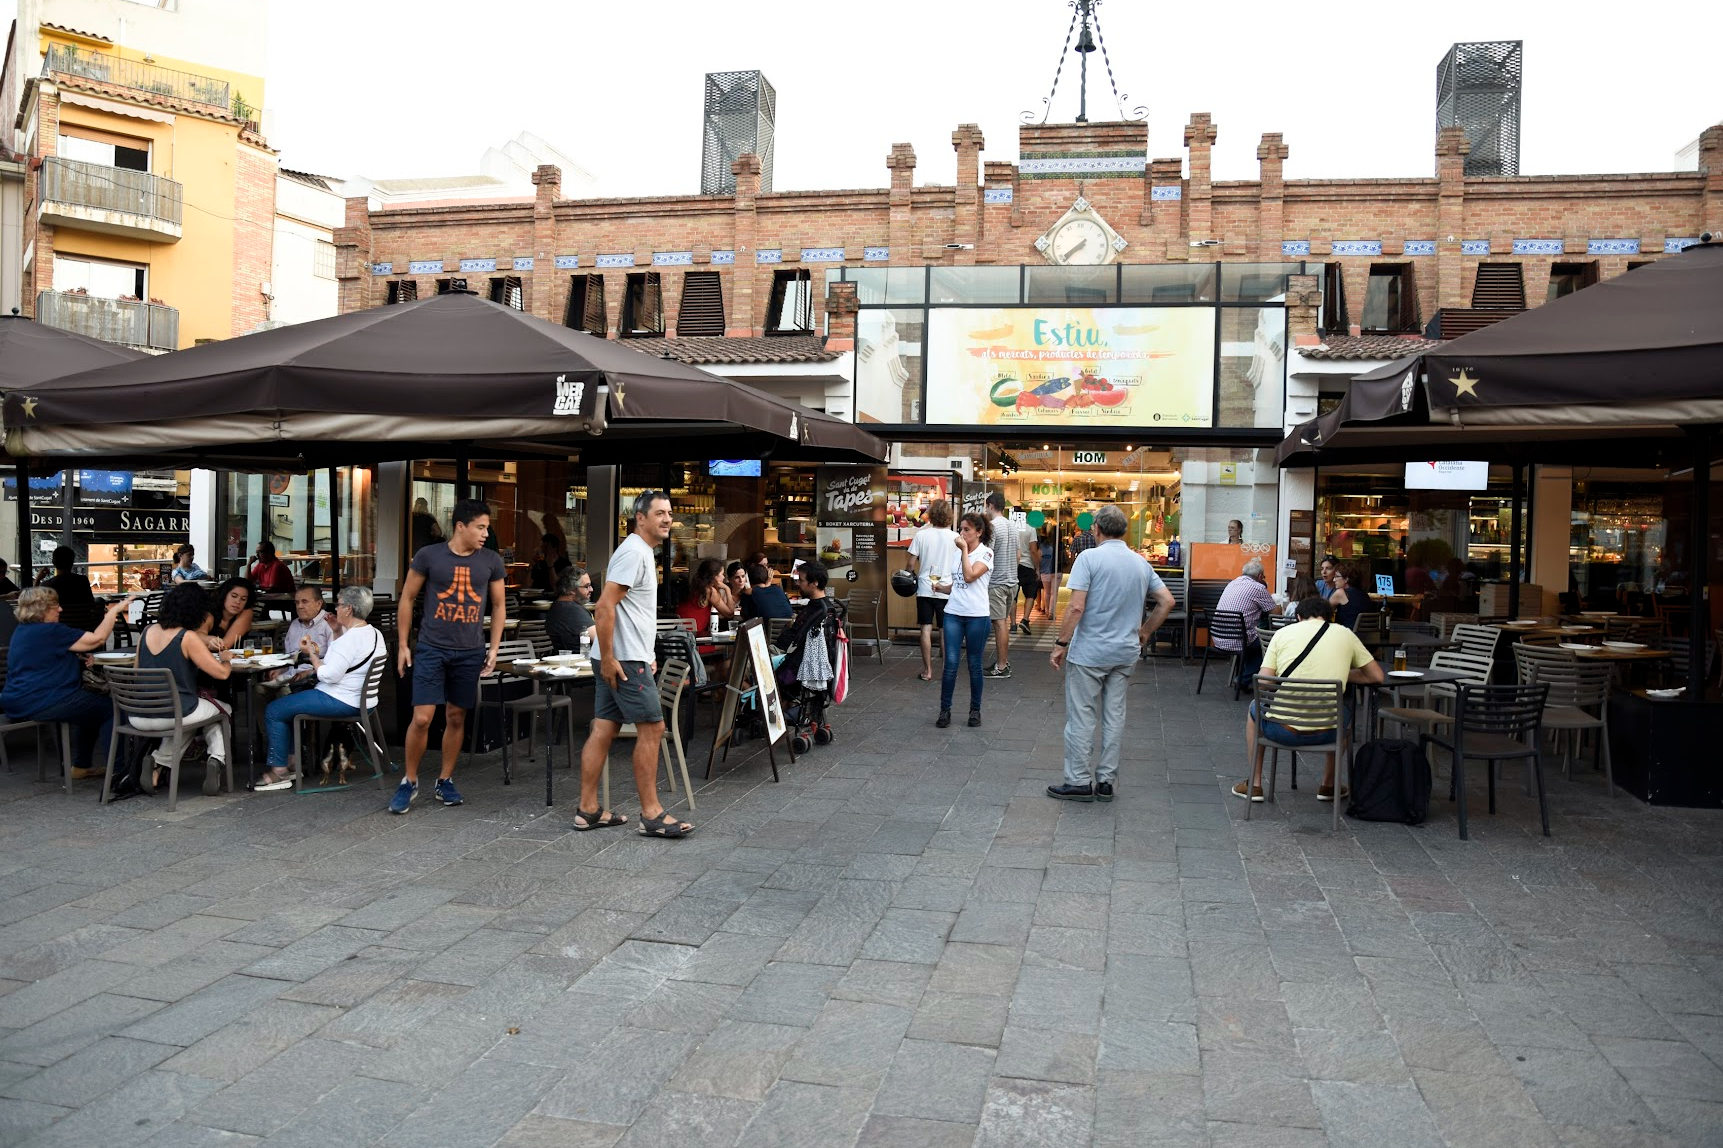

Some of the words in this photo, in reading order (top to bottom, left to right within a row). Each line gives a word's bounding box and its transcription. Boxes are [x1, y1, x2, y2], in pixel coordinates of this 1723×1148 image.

[1033, 318, 1109, 348] Estiu,
[981, 350, 996, 359] als
[998, 350, 1037, 360] mercats,
[1039, 349, 1084, 361] productes
[1086, 349, 1098, 359] de
[556, 374, 566, 382] el
[556, 381, 585, 397] MER
[1074, 452, 1106, 463] HOM
[826, 478, 849, 491] Sant
[848, 473, 872, 487] Cugat
[1031, 484, 1063, 495] HOM
[825, 489, 885, 512] Tapes
[31, 513, 54, 525] DES
[72, 517, 95, 525] 1960
[120, 510, 190, 531] SAGARR
[1009, 511, 1027, 521] MER
[1377, 576, 1392, 587] 175
[434, 601, 481, 623] ATARI
